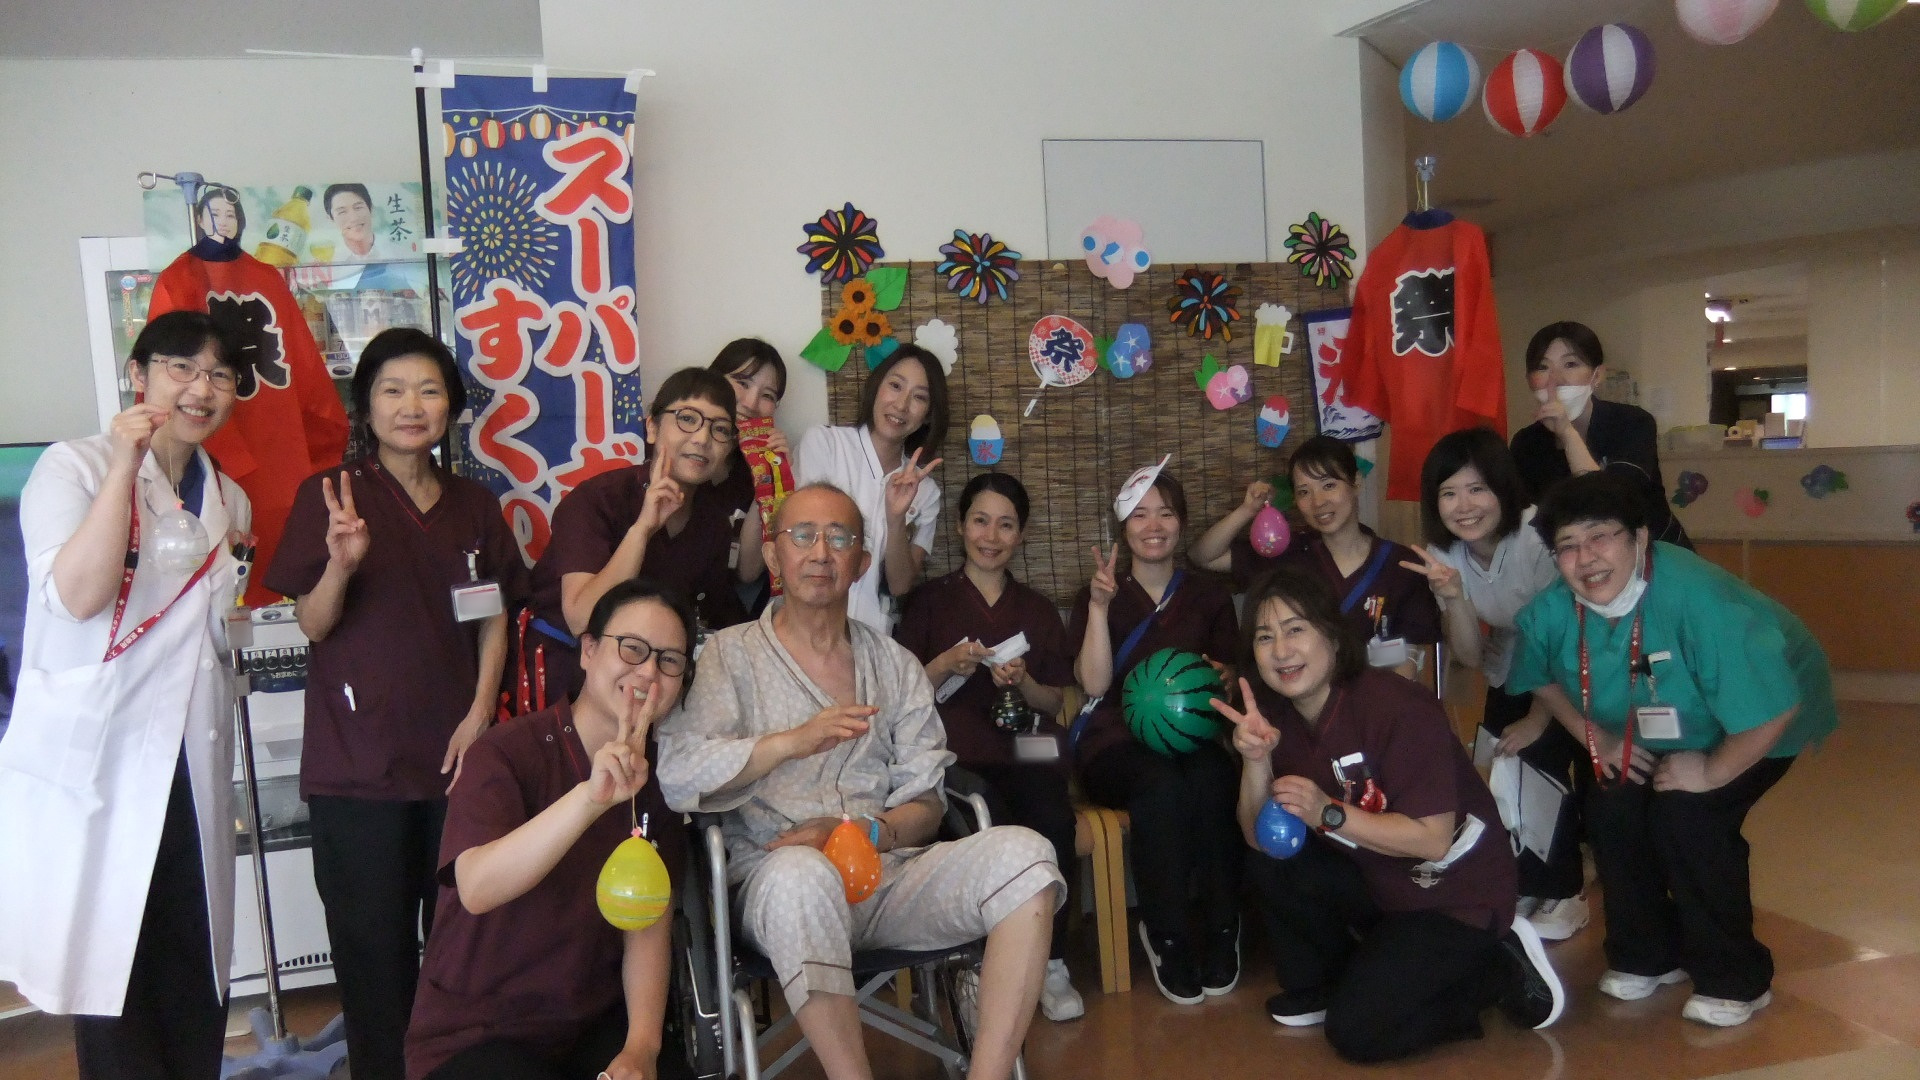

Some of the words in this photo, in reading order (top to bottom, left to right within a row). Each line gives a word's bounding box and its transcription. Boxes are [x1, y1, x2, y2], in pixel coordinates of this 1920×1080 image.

[388, 192, 413, 242] 生茶
[1039, 327, 1085, 373] 祭
[974, 440, 997, 461] 氷
